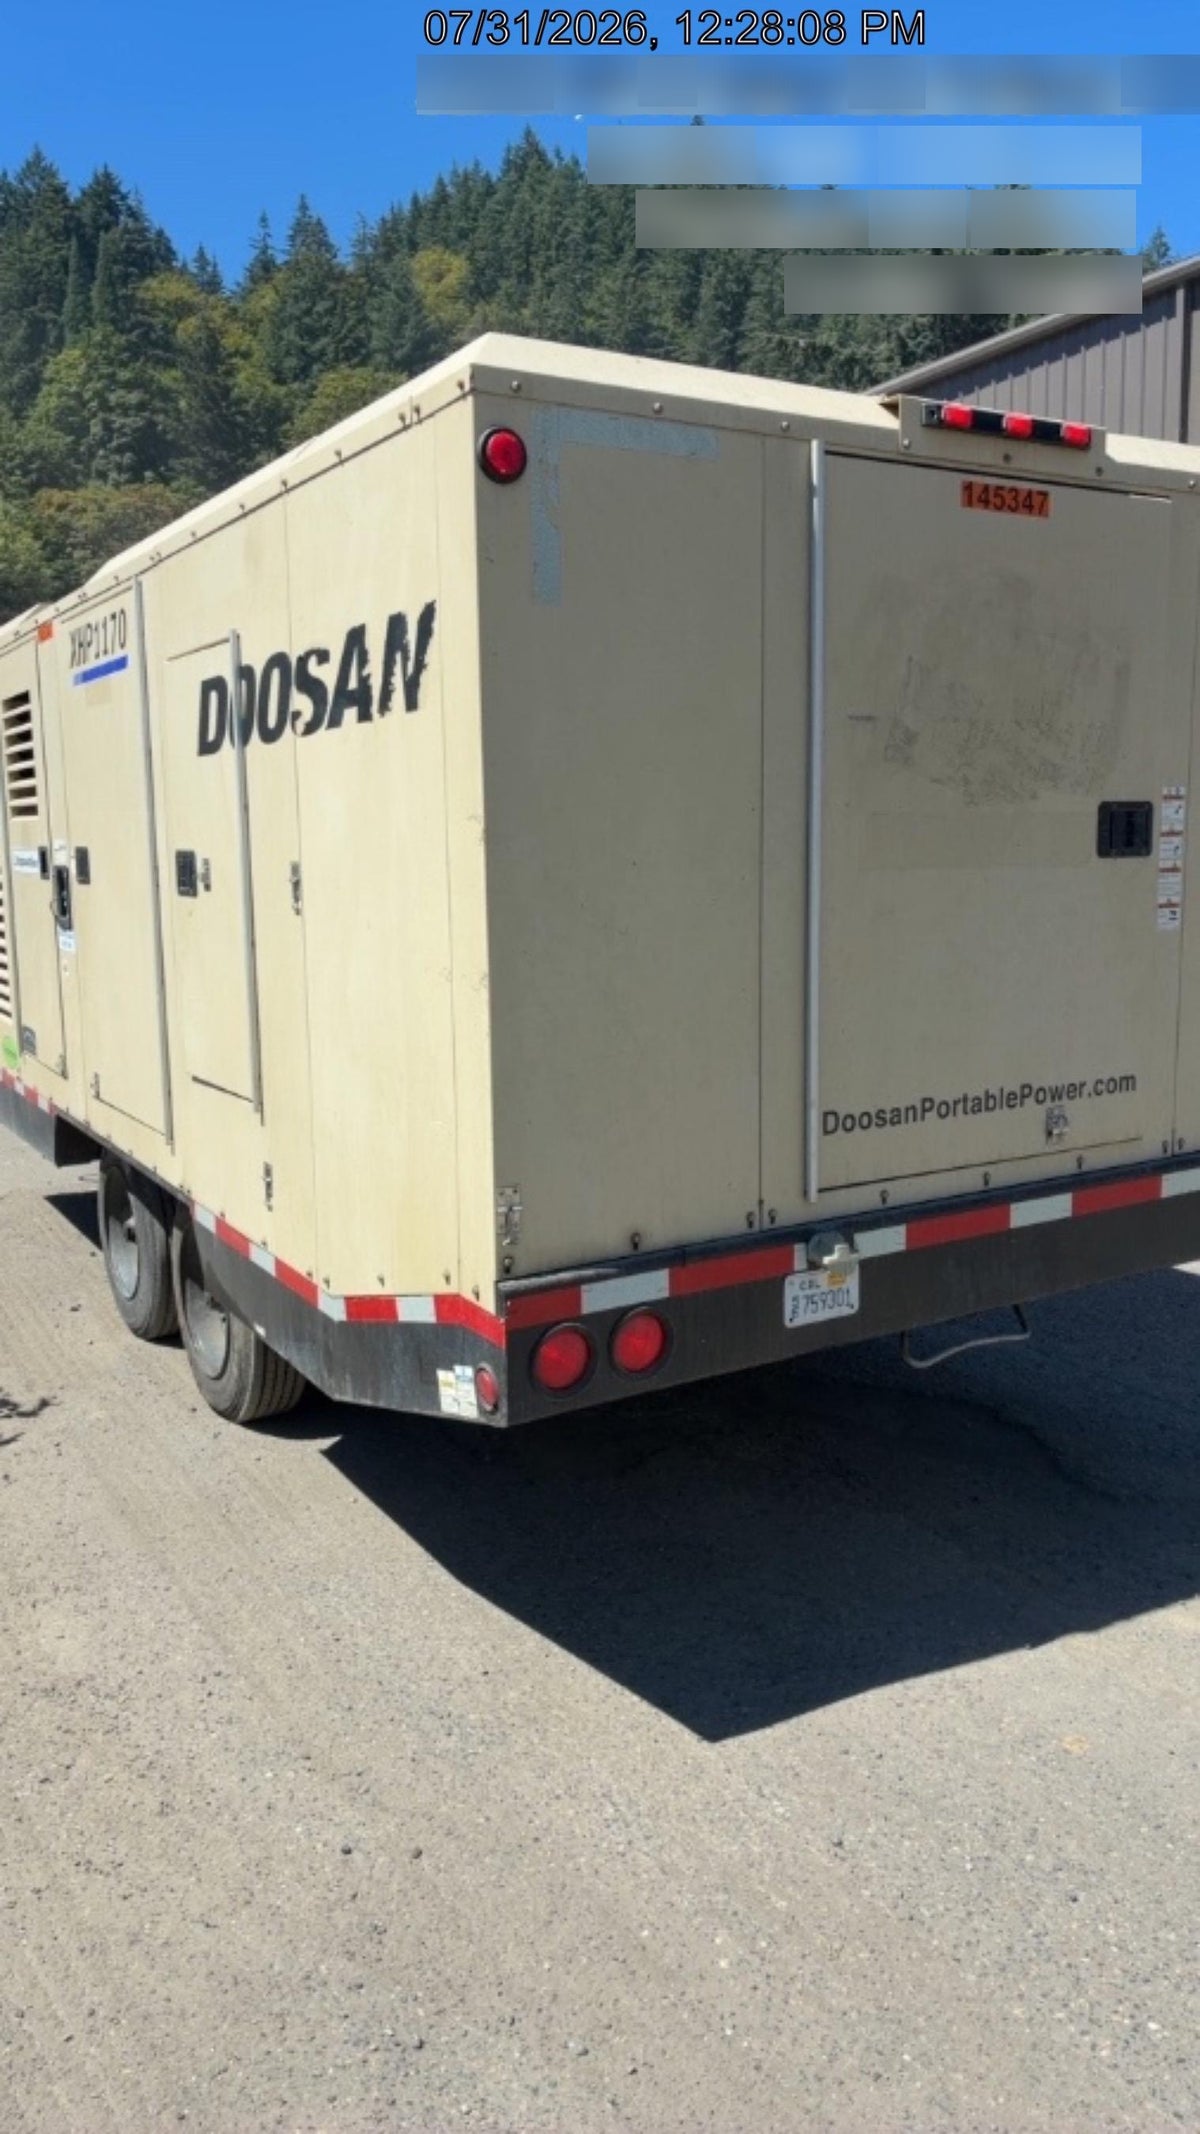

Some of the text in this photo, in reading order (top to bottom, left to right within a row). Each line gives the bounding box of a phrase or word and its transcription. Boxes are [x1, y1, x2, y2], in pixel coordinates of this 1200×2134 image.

[962, 481, 1049, 516] 145347
[69, 608, 127, 669] XHP1170
[197, 599, 437, 757] DOOSAN
[822, 1073, 1137, 1136] DoosanPortablePower.com
